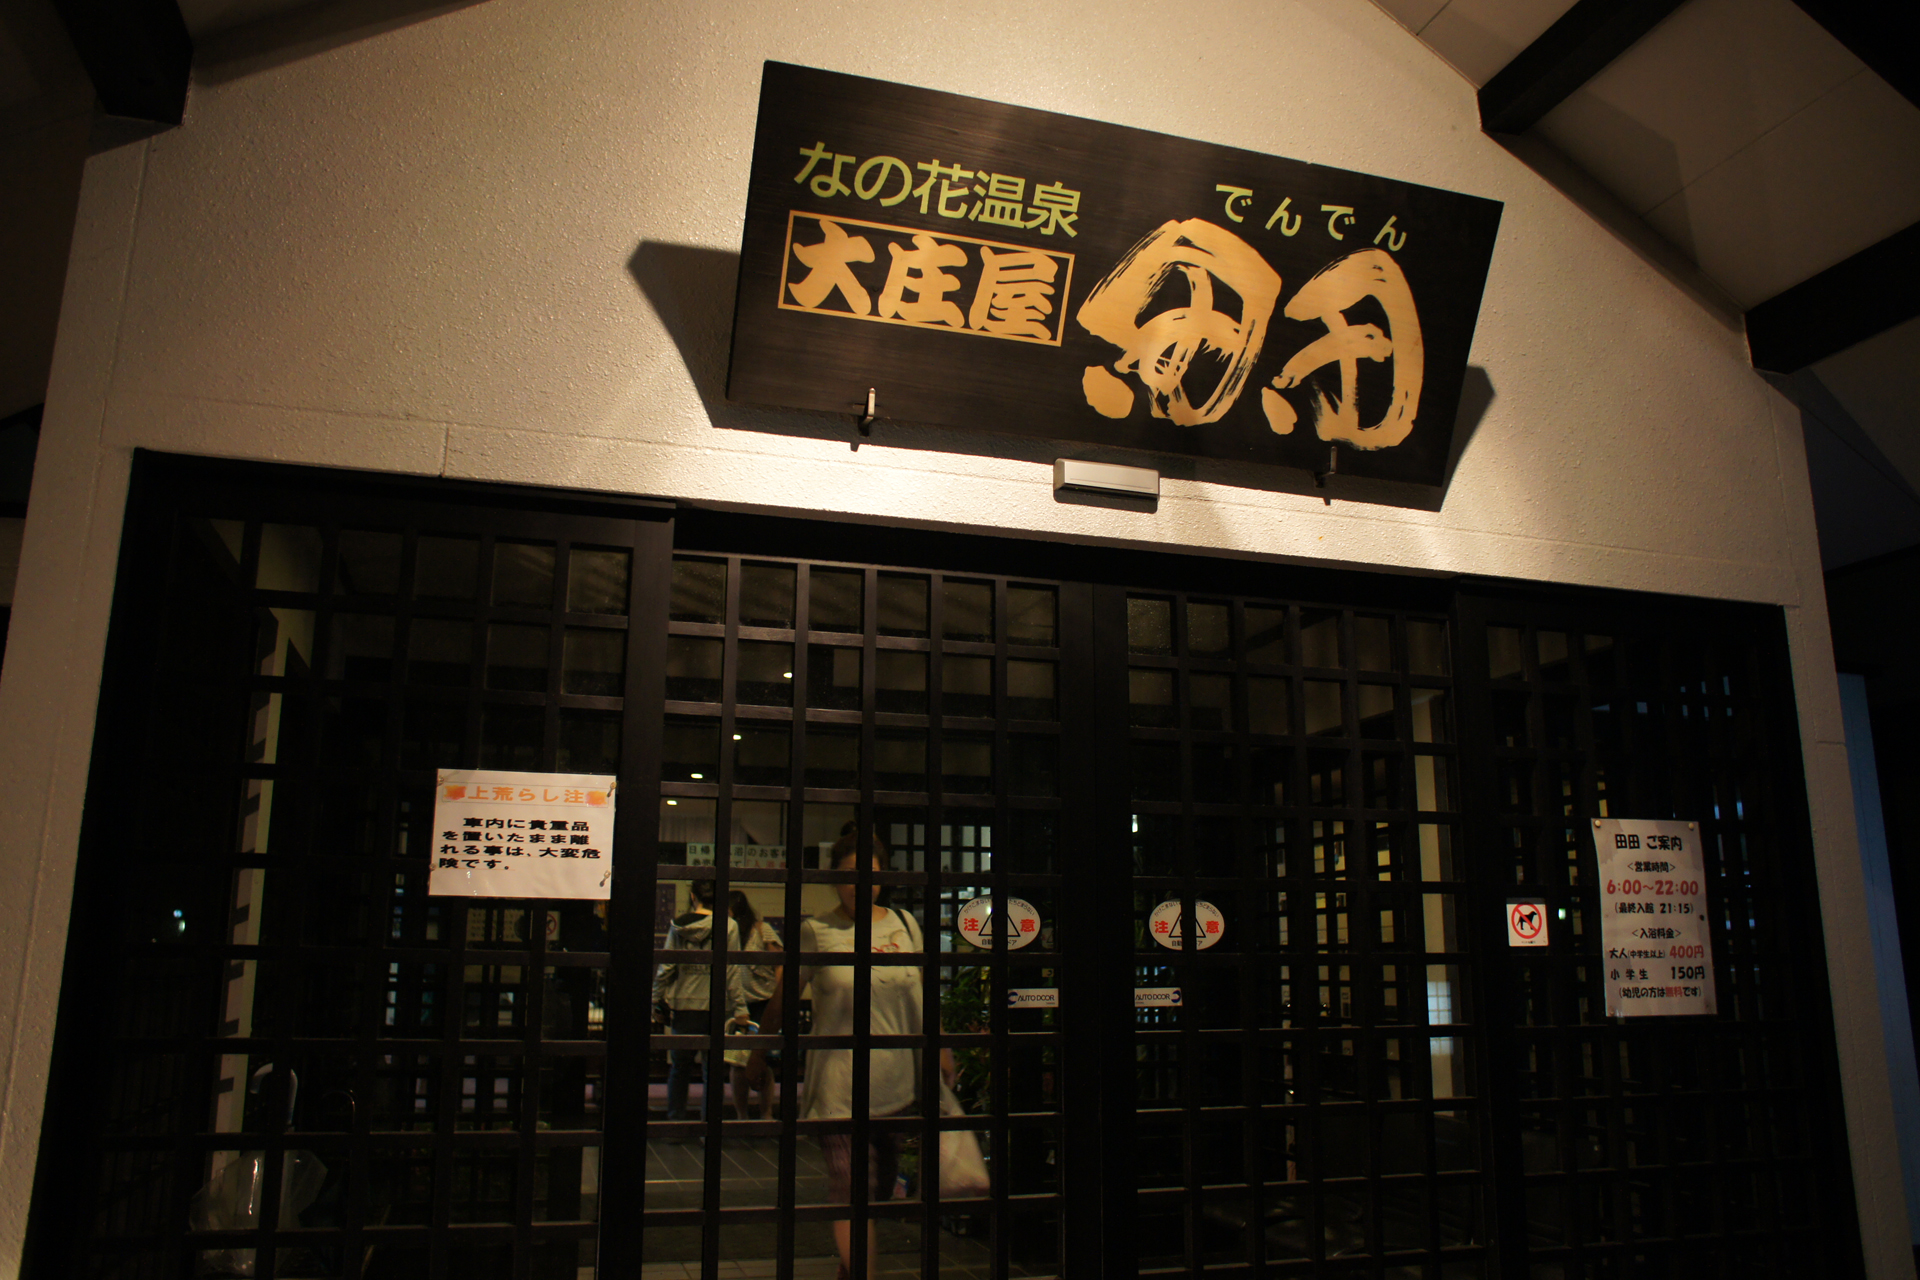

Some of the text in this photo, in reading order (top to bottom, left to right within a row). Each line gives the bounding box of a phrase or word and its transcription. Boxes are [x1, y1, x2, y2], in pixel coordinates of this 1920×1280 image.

[794, 142, 1081, 238] なの花温泉
[1216, 184, 1408, 252] でんでん
[788, 220, 1060, 342] 大庄屋
[463, 817, 590, 832] 車内に貴重品
[442, 831, 590, 846] を置いたまま離
[1615, 834, 1683, 851] 田田 ご案内
[440, 845, 601, 860] れる事は、大変危
[439, 858, 510, 870] 険です。
[964, 918, 1035, 932] 注 意
[1155, 921, 1219, 933] 注 意
[1669, 945, 1705, 959] 400円
[1671, 966, 1706, 980] 150円
[1017, 994, 1055, 1002] AUTO DOOR
[1136, 993, 1171, 1001] AUTO DOOR
